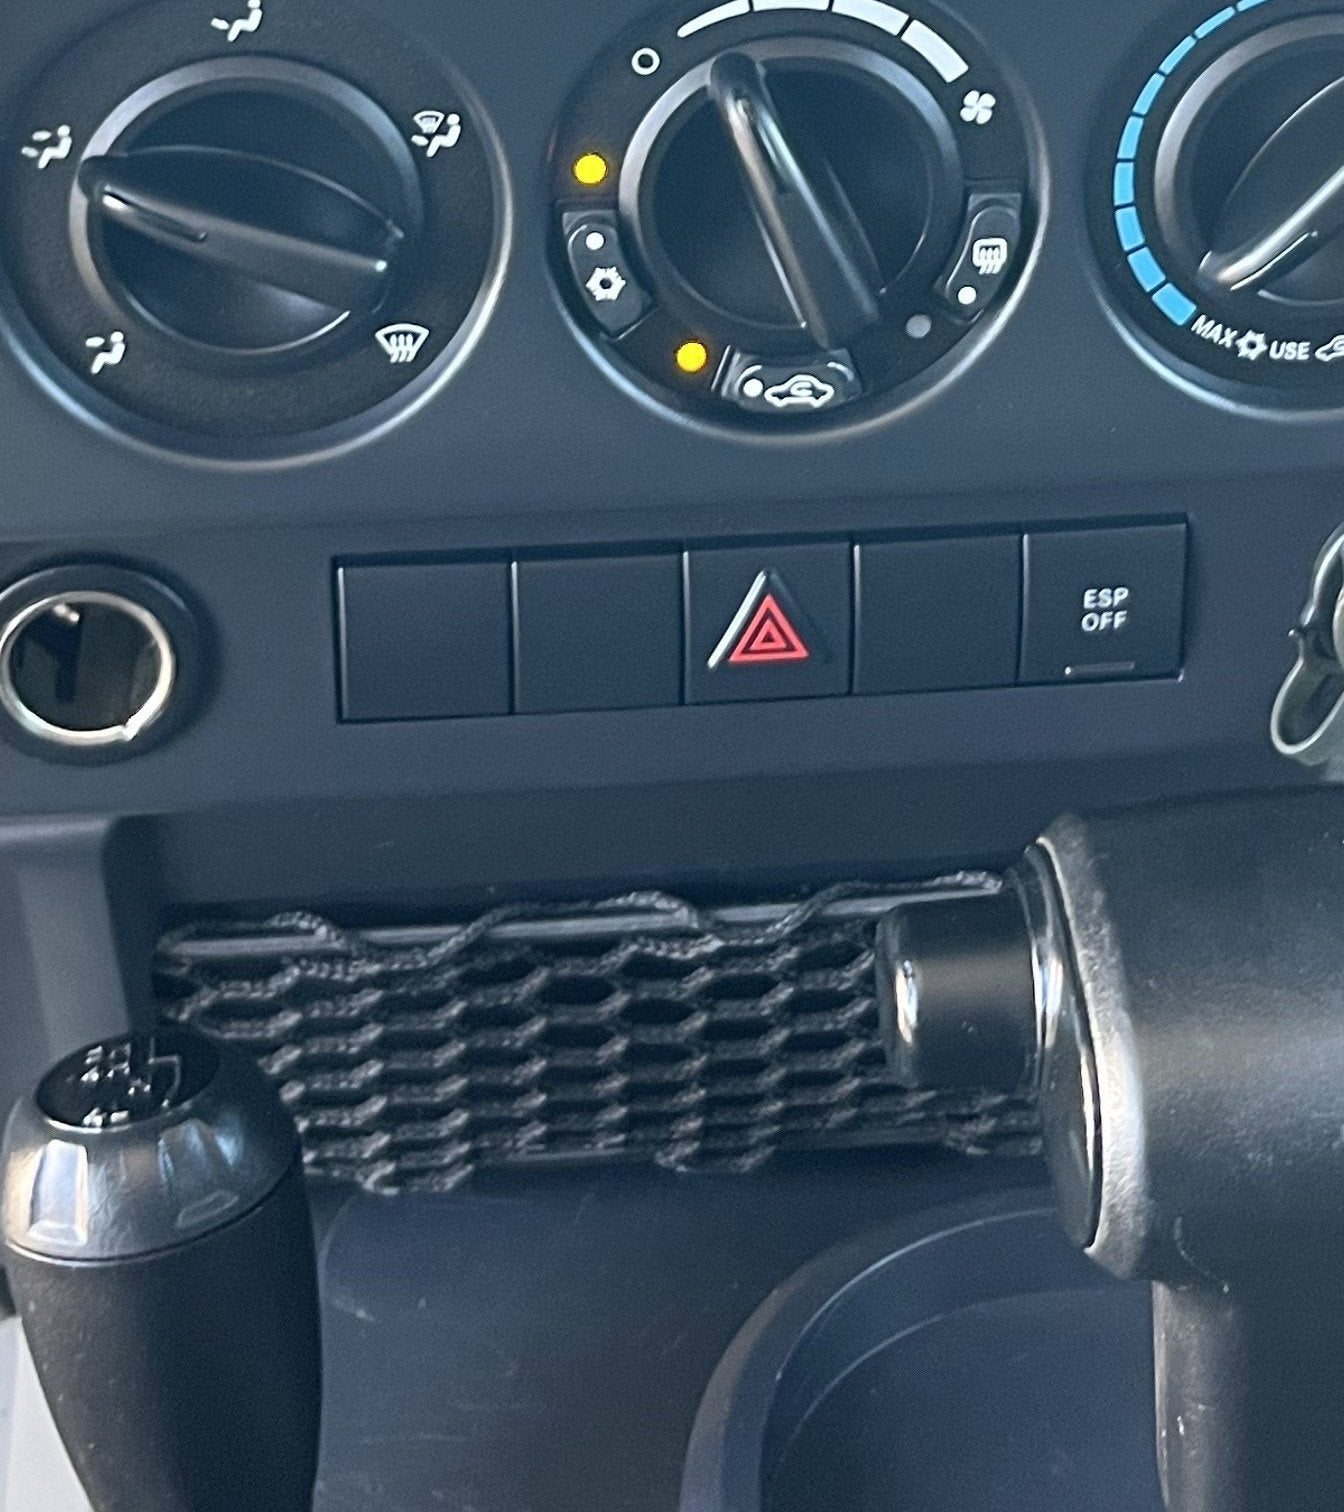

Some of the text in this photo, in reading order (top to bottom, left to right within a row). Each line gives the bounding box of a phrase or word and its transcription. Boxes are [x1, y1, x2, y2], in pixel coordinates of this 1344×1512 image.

[1190, 314, 1312, 361] MAX USE
[1082, 587, 1129, 609] ESP
[1081, 610, 1128, 632] OFF
